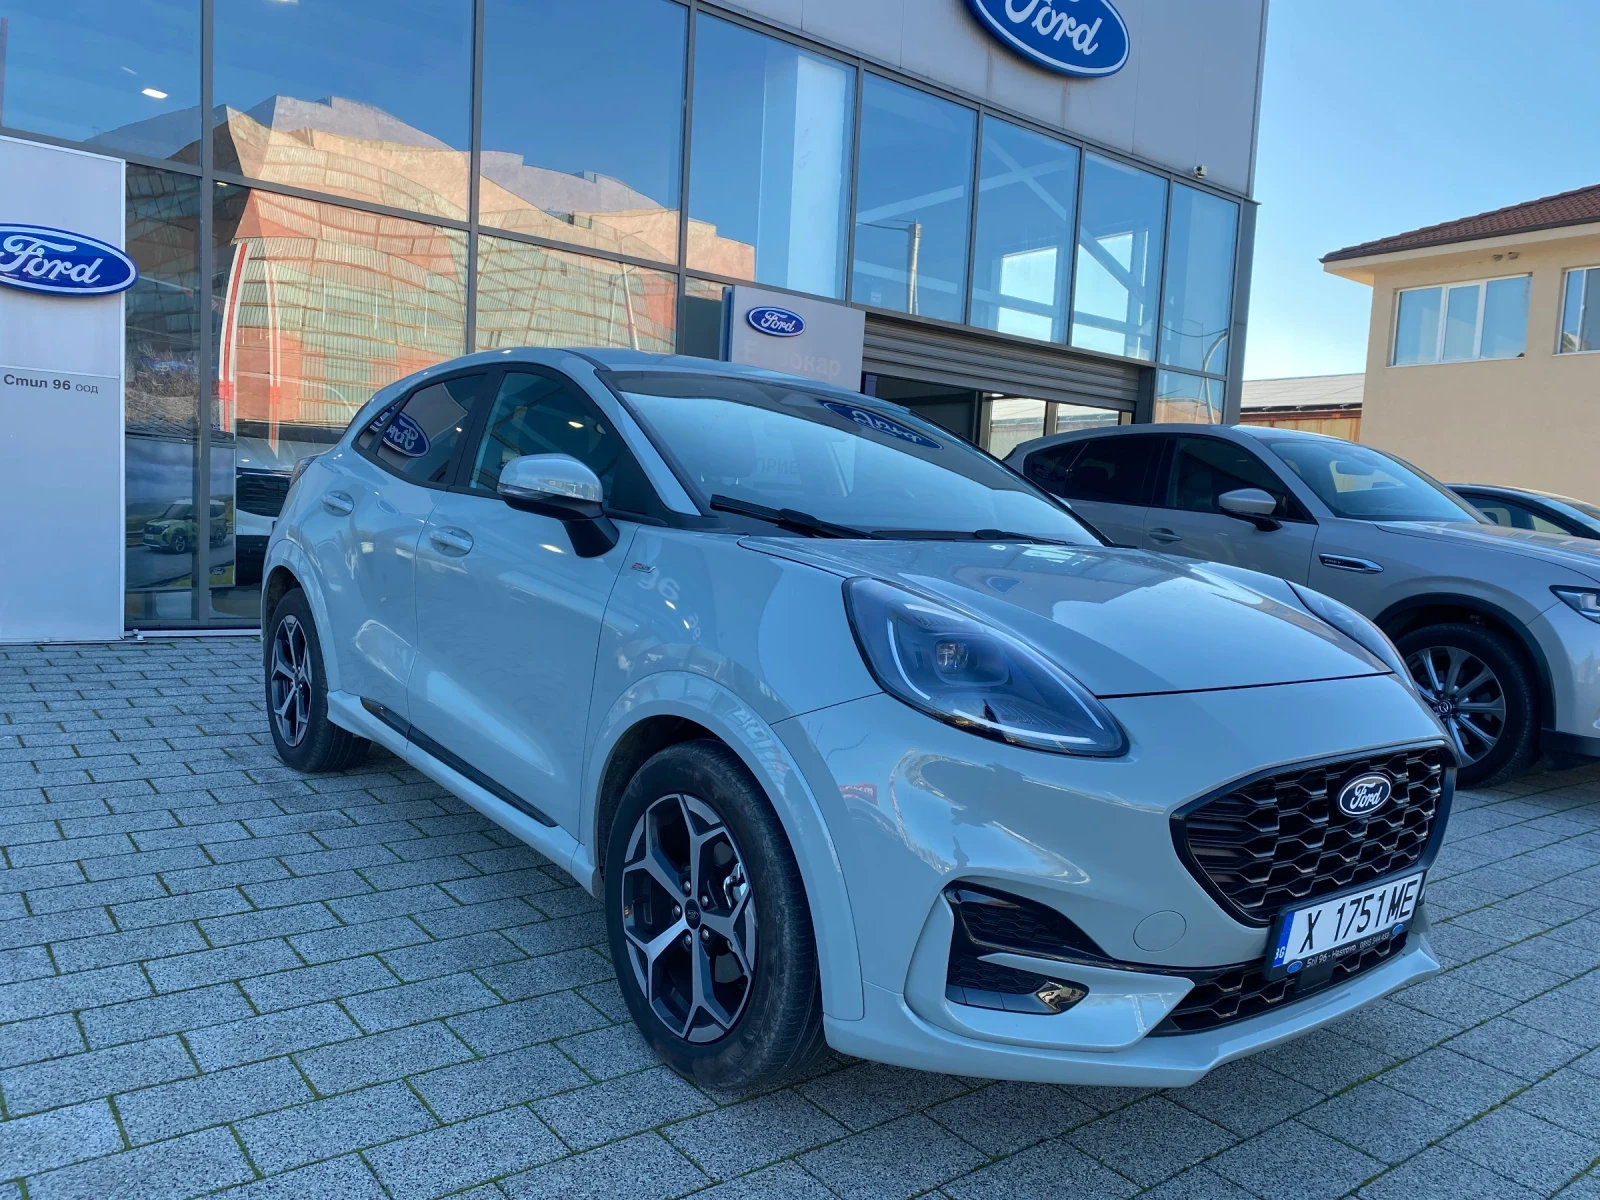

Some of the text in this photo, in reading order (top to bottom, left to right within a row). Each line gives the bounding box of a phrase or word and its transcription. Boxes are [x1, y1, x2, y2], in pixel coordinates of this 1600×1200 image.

[0, 234, 104, 284] Ford
[760, 310, 796, 332] Ford
[3, 373, 48, 389] Стил
[52, 378, 71, 391] 96
[1349, 782, 1383, 810] Ford
[1298, 909, 1322, 954] X
